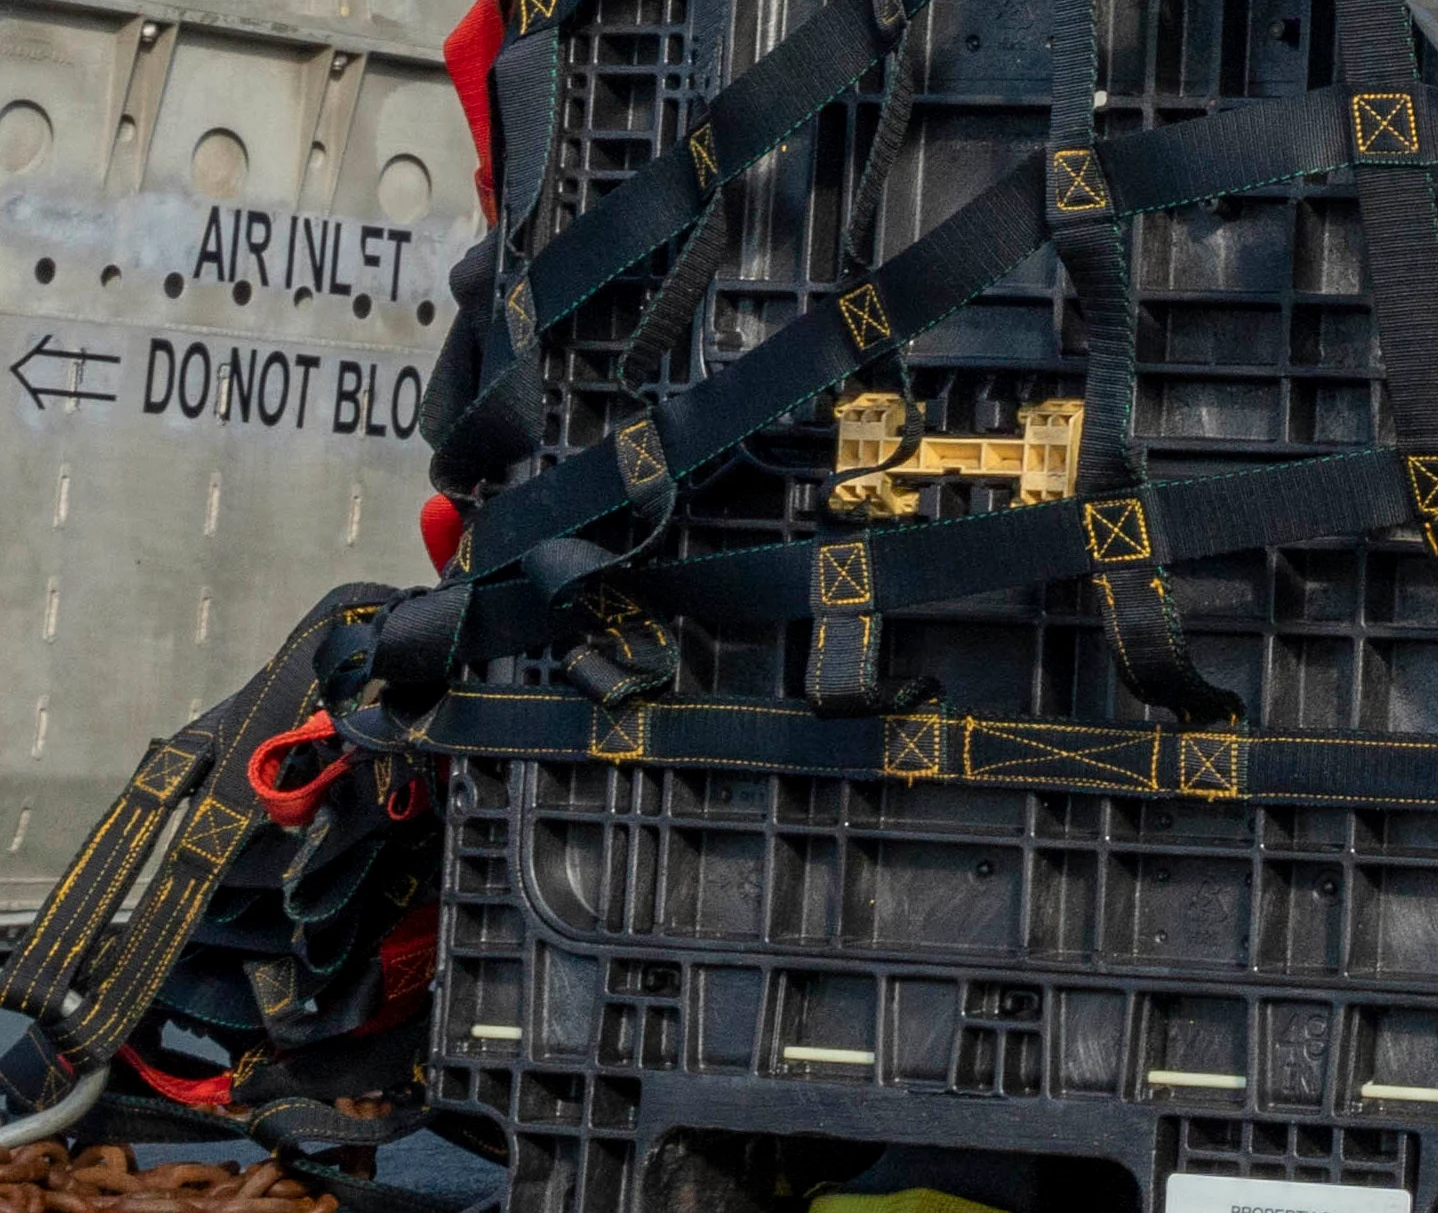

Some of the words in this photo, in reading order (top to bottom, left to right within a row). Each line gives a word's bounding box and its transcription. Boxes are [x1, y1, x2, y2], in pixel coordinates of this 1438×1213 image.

[193, 205, 272, 287] AIR
[143, 337, 211, 419] DO
[222, 347, 321, 429] NOT
